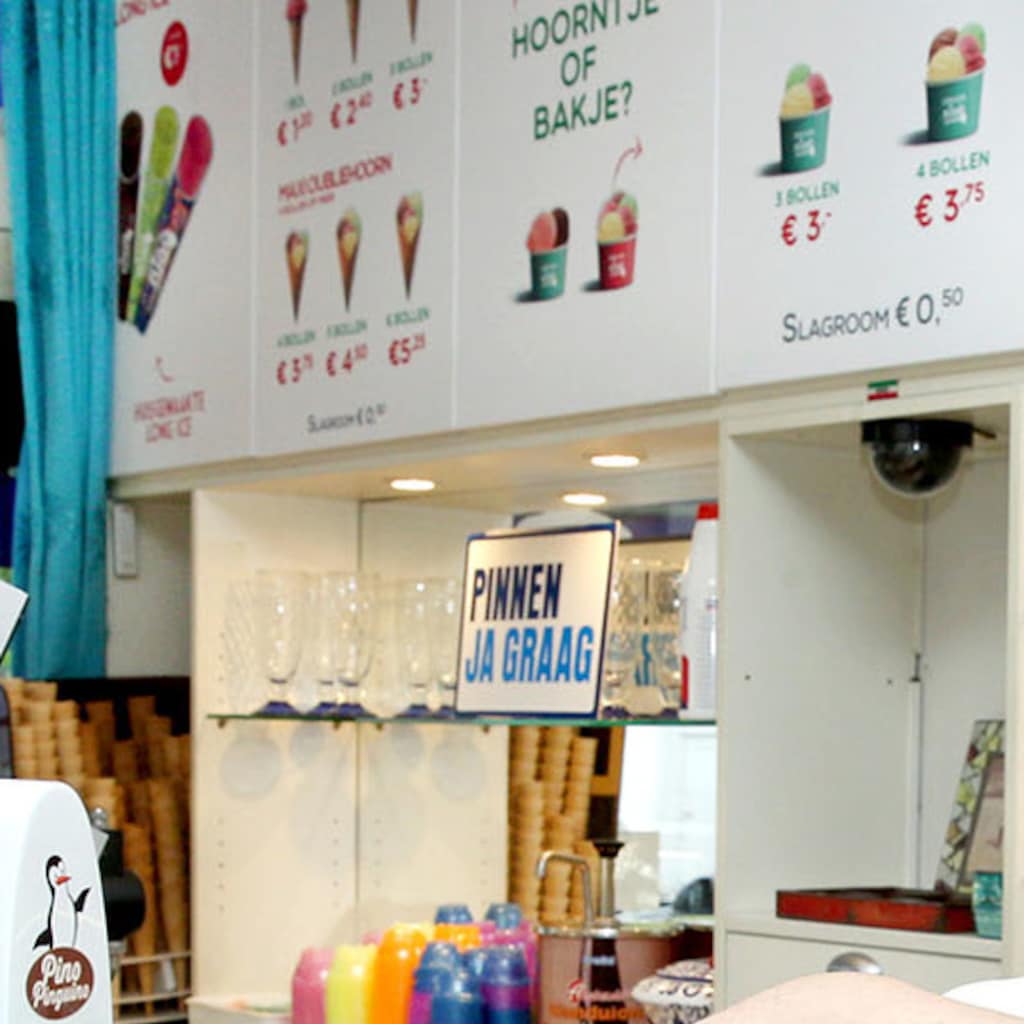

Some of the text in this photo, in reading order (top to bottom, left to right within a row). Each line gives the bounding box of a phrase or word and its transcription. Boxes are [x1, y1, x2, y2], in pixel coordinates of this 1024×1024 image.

[560, 44, 597, 87] OF
[533, 80, 633, 141] BAKJE?
[930, 149, 990, 177] BOLLEN
[786, 179, 841, 206] BOLLEN
[914, 193, 933, 227] €
[781, 214, 798, 247] €
[895, 295, 910, 327] €
[470, 562, 562, 622] PINNEN
[466, 625, 595, 684] JA GRAAG
